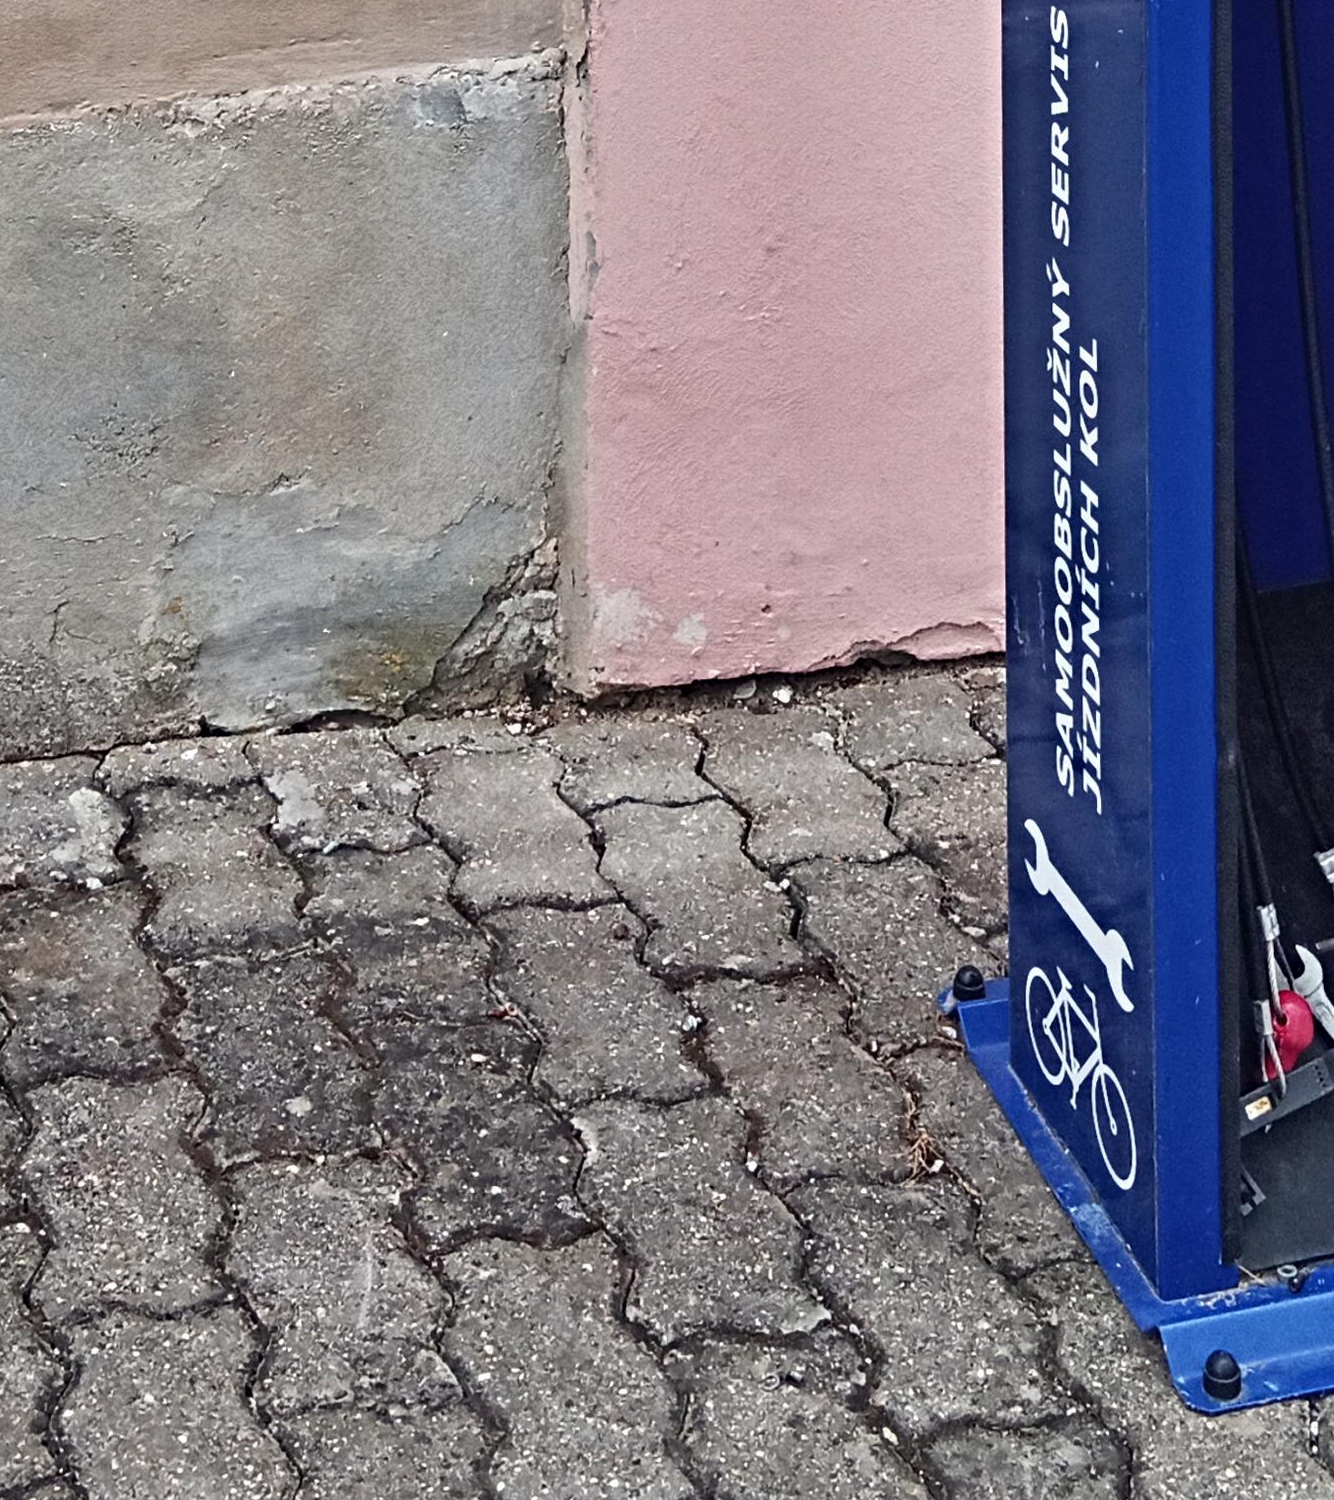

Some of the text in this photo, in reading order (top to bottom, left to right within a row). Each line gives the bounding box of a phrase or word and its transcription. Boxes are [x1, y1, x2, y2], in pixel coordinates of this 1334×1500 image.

[1046, 5, 1074, 797] SAMOOBSLUŽNÝ SERVIS
[1076, 338, 1102, 815] JÍZDNÍCH KOL
